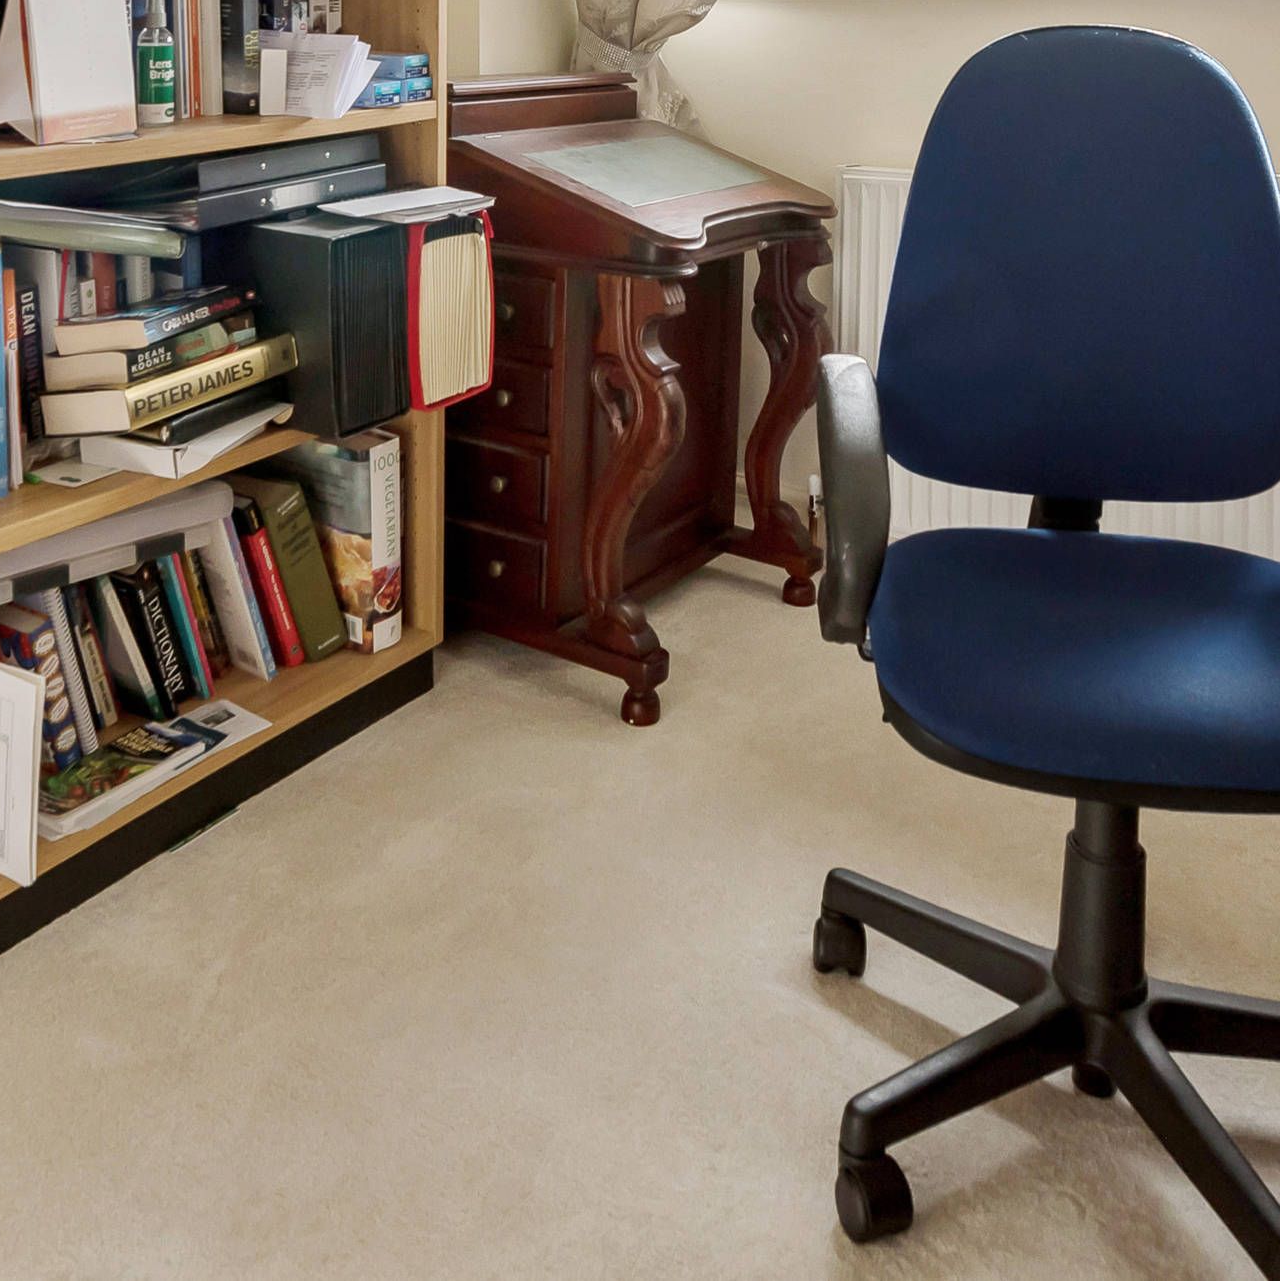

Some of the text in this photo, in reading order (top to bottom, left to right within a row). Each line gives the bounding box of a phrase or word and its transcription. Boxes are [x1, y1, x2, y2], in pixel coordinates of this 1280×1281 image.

[149, 59, 173, 69] Lens
[20, 291, 37, 336] DEAN
[131, 351, 173, 374] KOONTZ
[137, 346, 166, 364] DEAN
[133, 360, 255, 419] PETER JAMES
[383, 474, 397, 558] VEGETARIAN
[147, 596, 185, 694] DICTIONARY
